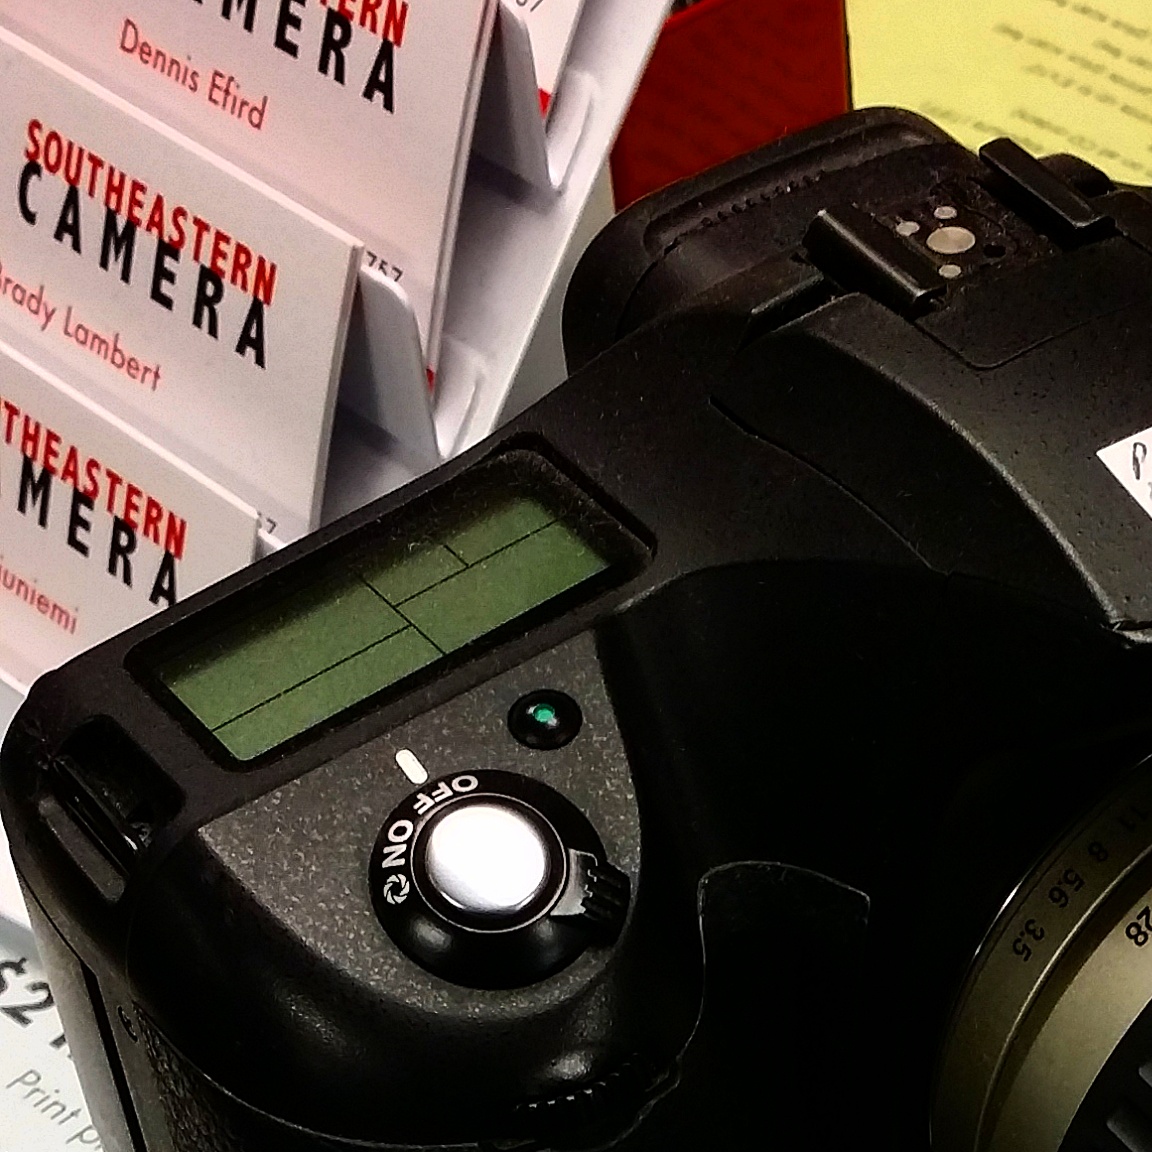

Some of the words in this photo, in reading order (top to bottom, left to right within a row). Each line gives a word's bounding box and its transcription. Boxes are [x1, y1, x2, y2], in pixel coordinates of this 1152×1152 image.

[120, 18, 200, 94] Dennis
[208, 69, 269, 130] Efird
[25, 119, 278, 306] SOUTHEASTERN
[18, 160, 267, 370] CAMERA
[63, 306, 161, 391] Lambert
[0, 562, 79, 635] uniemi
[413, 775, 479, 815] OFF
[381, 820, 414, 868] ON
[1012, 918, 1045, 962] 3.5
[1048, 869, 1084, 909] 5.6
[5, 1069, 82, 1126] Print
